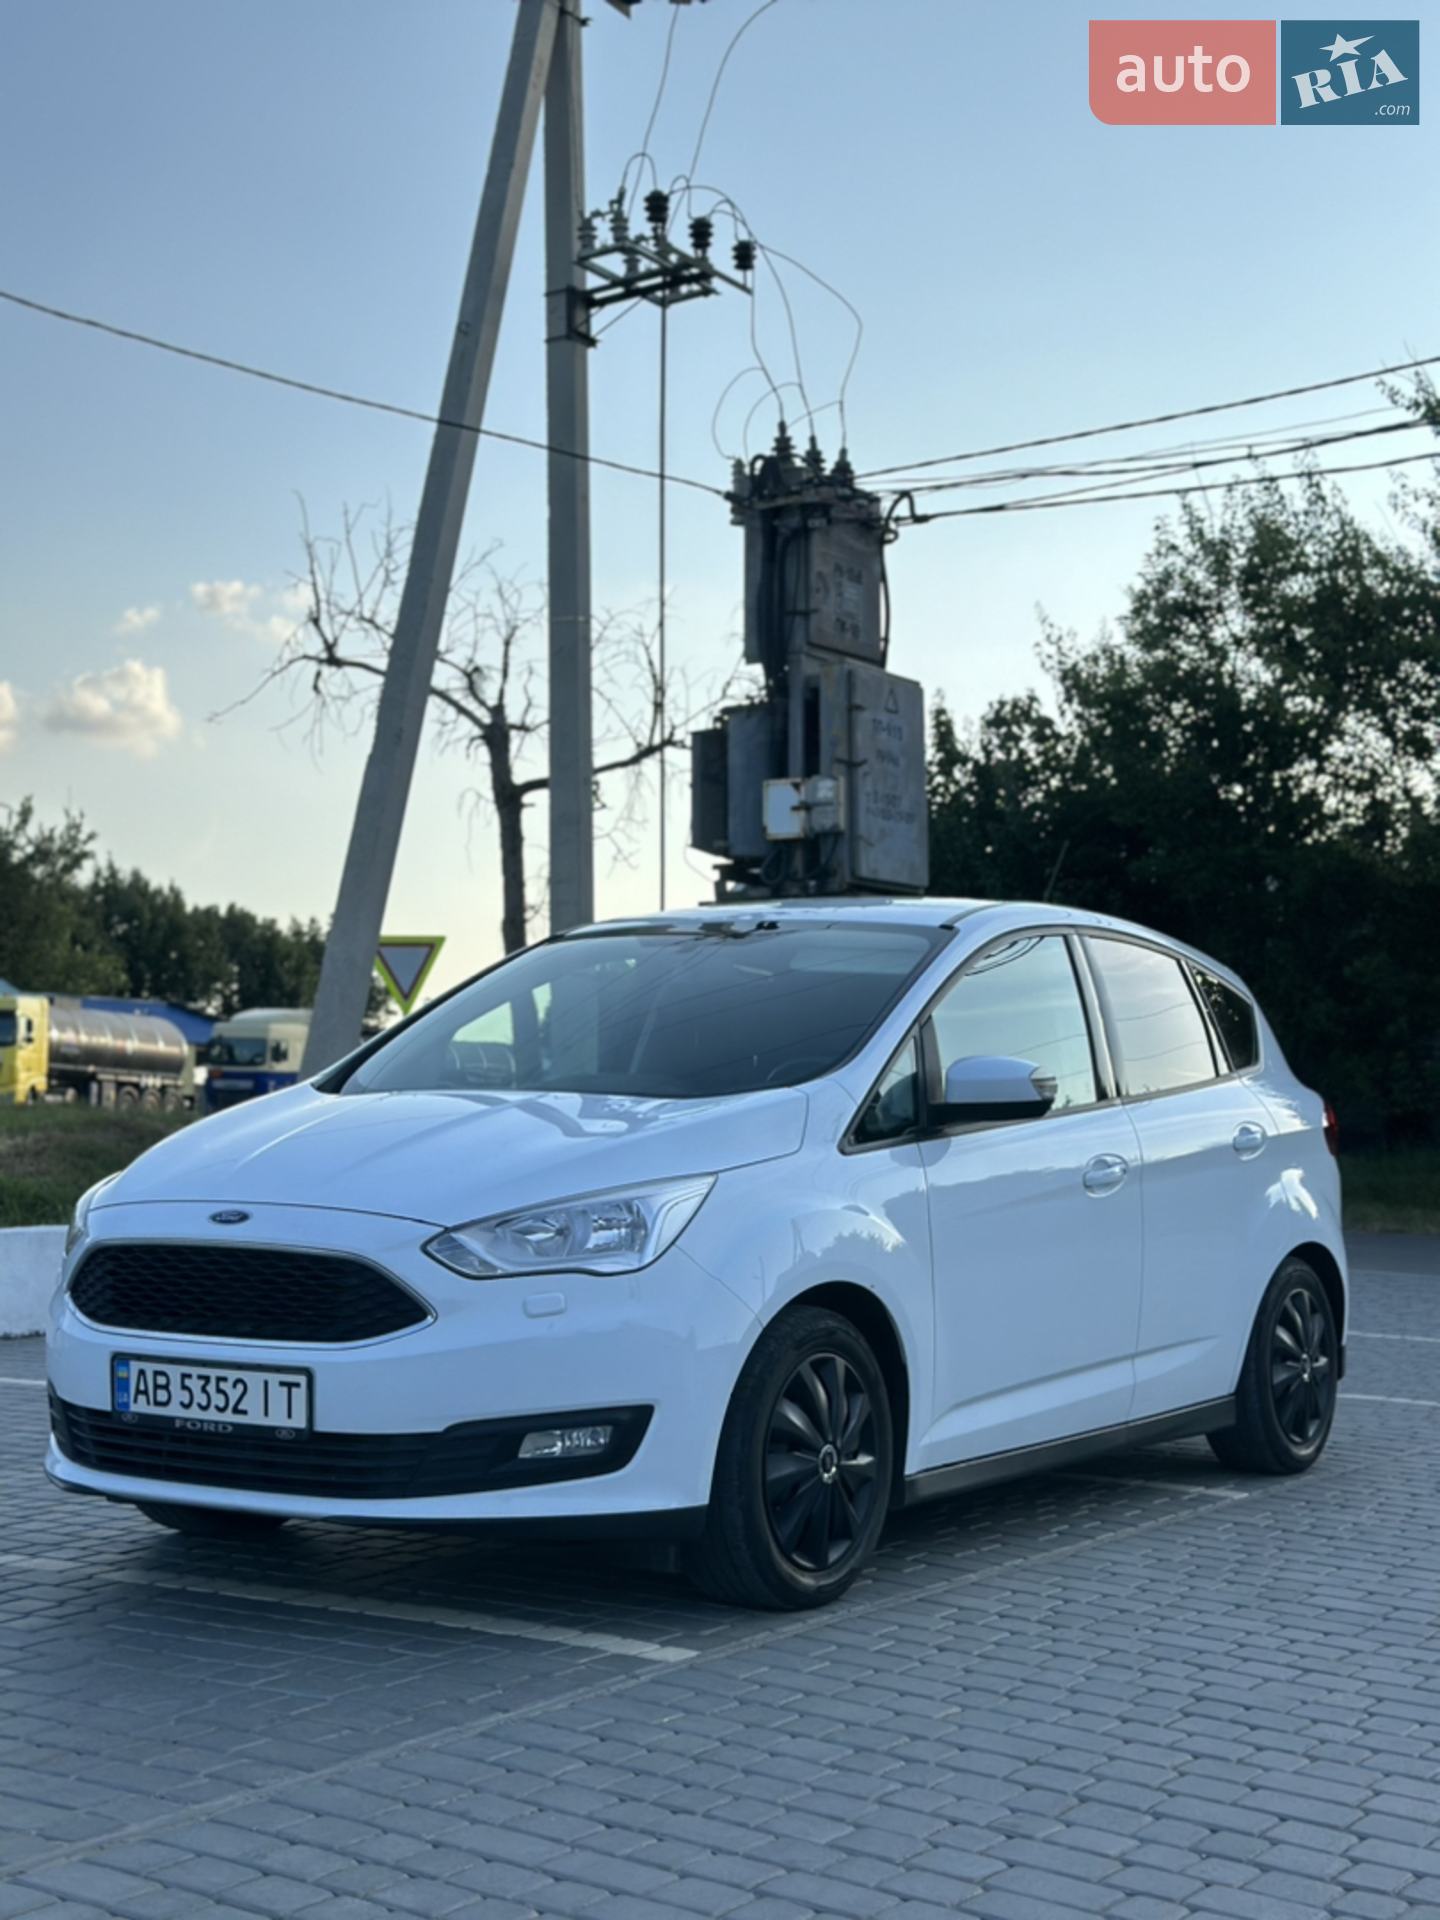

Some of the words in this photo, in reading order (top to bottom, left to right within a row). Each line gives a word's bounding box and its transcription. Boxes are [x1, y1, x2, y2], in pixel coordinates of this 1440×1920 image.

[133, 1368, 172, 1407] AB
[179, 1372, 249, 1416] 5352
[263, 1379, 301, 1420] IT
[174, 1418, 234, 1433] FORD
